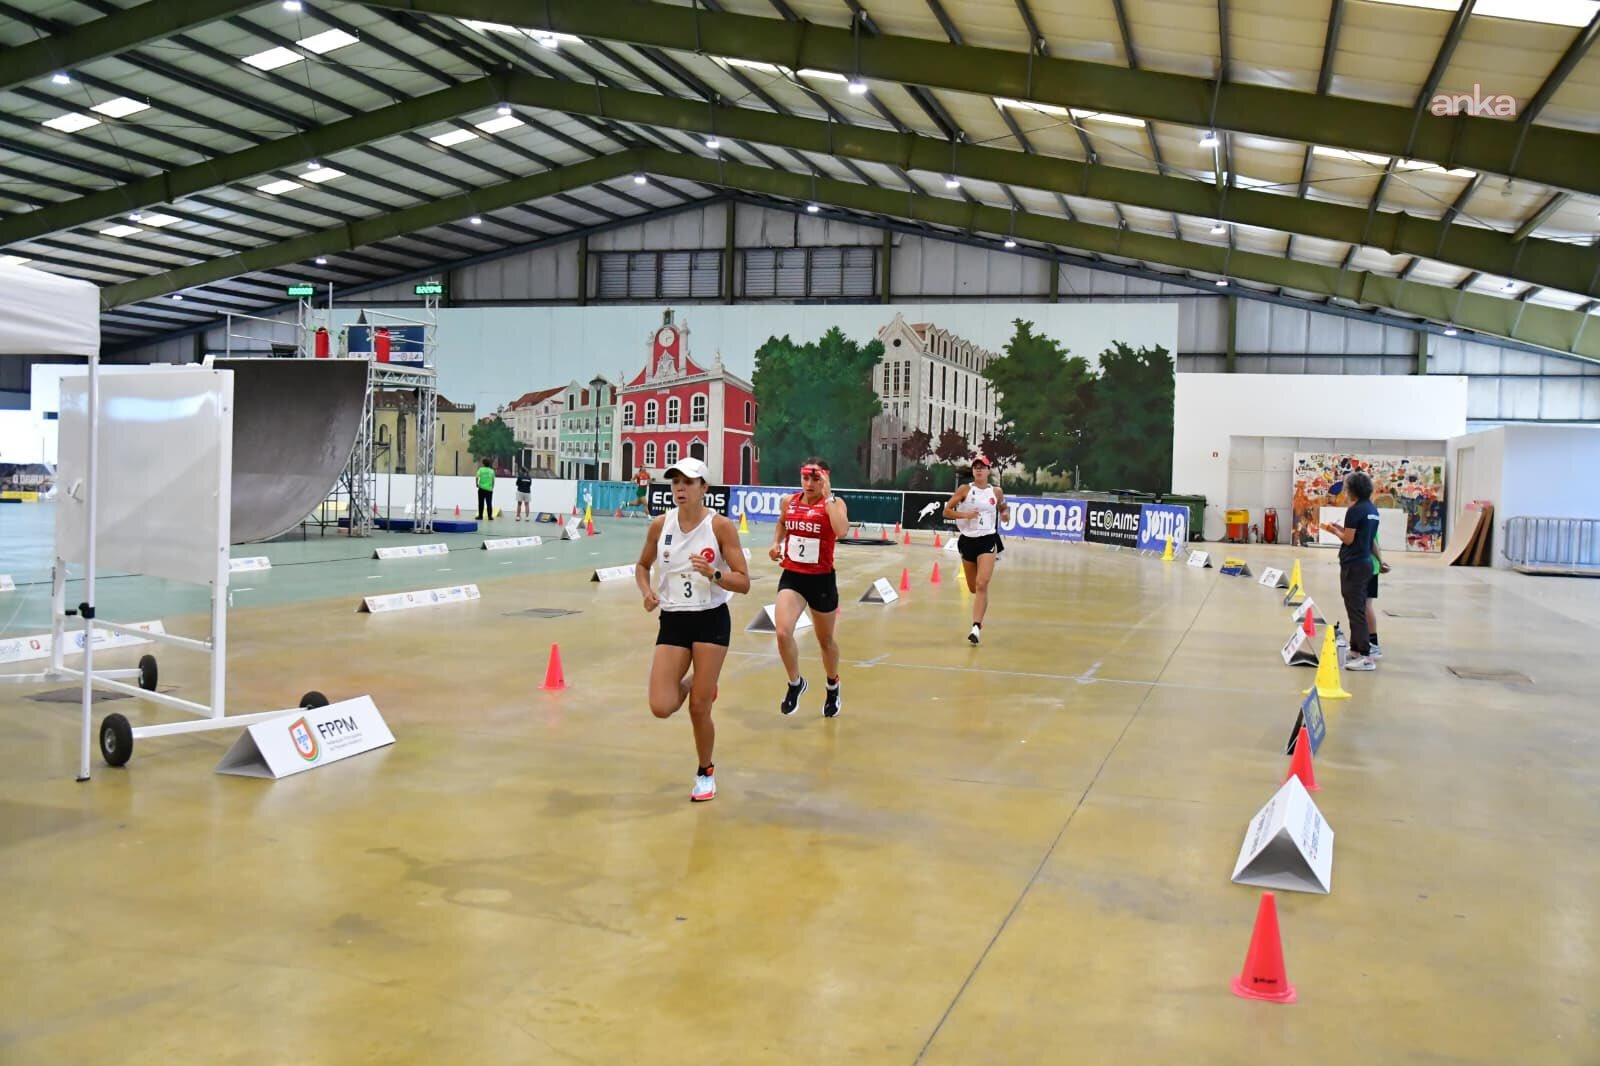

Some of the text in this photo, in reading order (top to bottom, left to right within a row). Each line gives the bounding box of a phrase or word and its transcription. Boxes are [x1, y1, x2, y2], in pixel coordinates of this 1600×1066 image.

[979, 517, 984, 526] 4
[1001, 502, 1083, 532] Joma
[785, 520, 822, 534] SUISSE
[798, 544, 805, 557] 2
[684, 581, 693, 598] 3
[317, 715, 359, 740] FPPM
